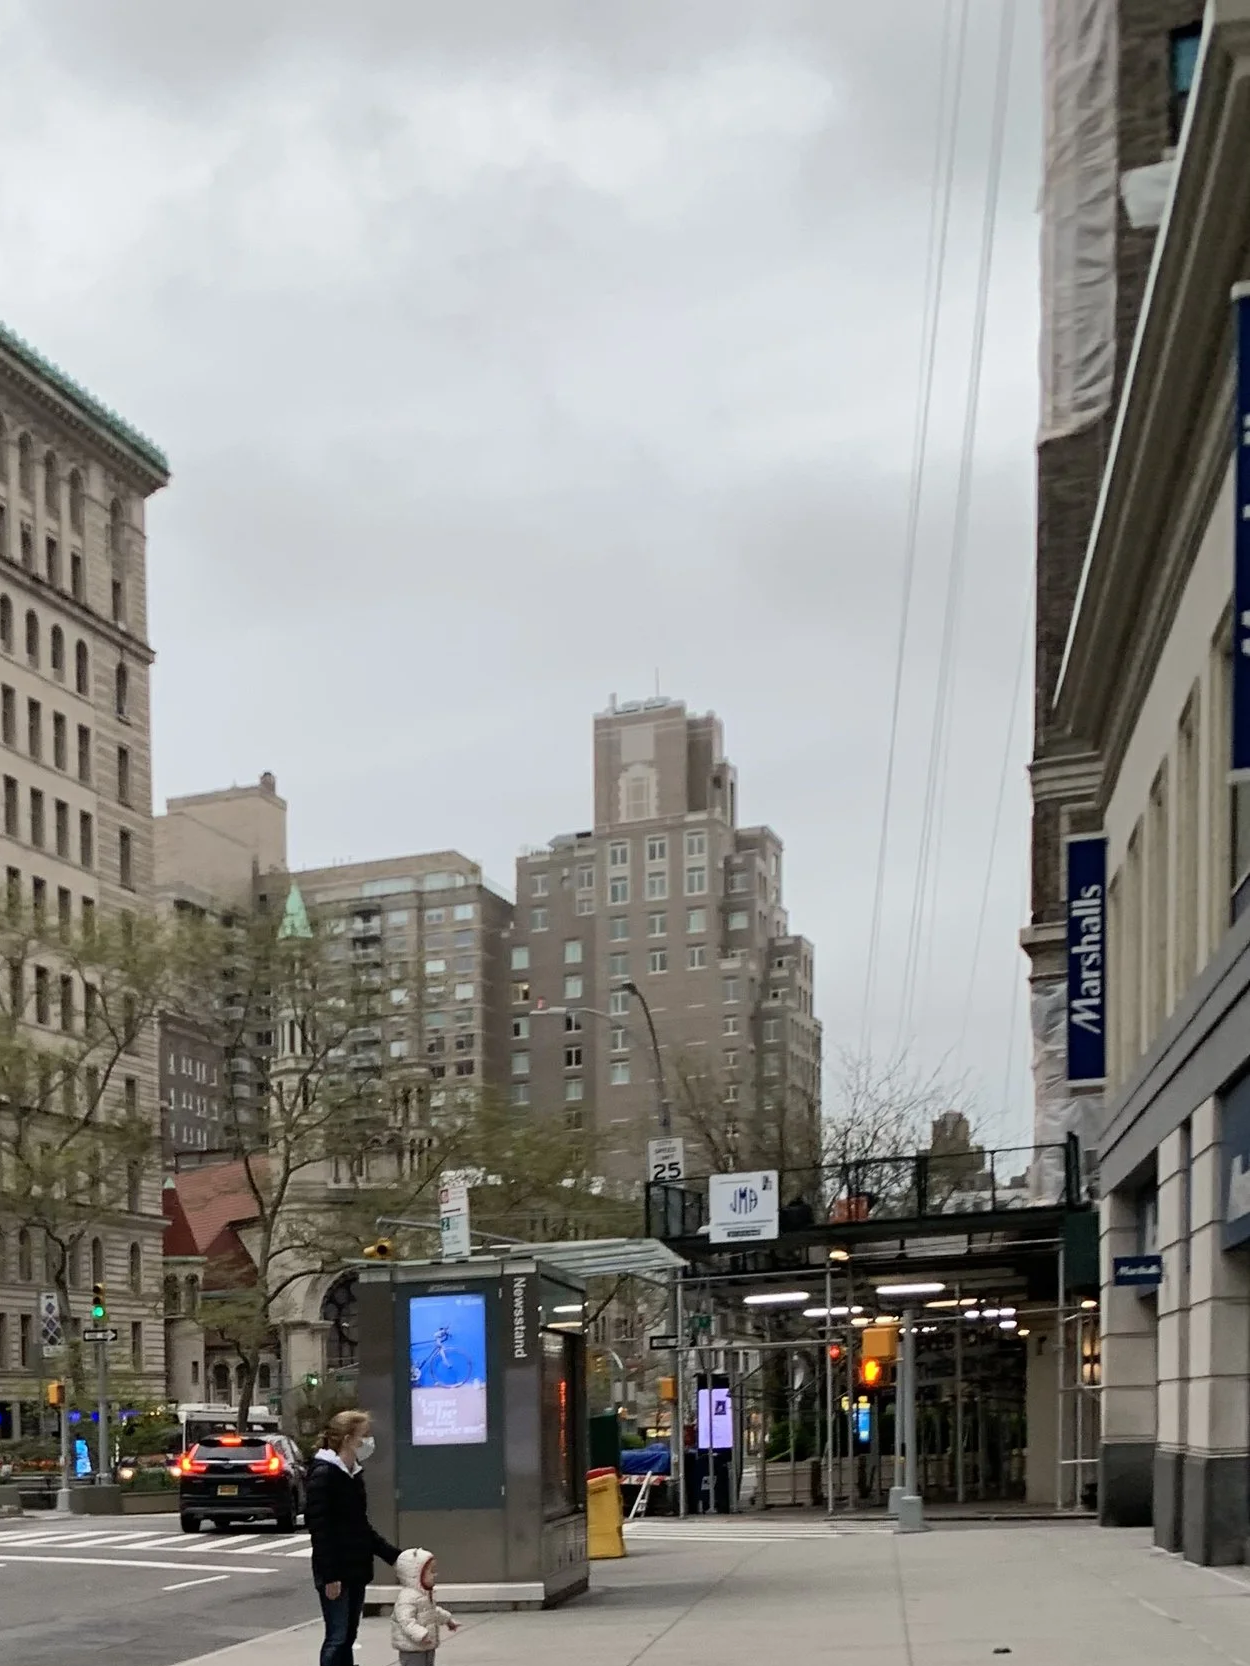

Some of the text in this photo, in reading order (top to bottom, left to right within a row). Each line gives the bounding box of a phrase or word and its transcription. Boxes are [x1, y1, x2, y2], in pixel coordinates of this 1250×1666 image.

[1070, 883, 1102, 1035] Marshalls
[653, 1161, 682, 1181] 25
[513, 1277, 528, 1359] Newsstand
